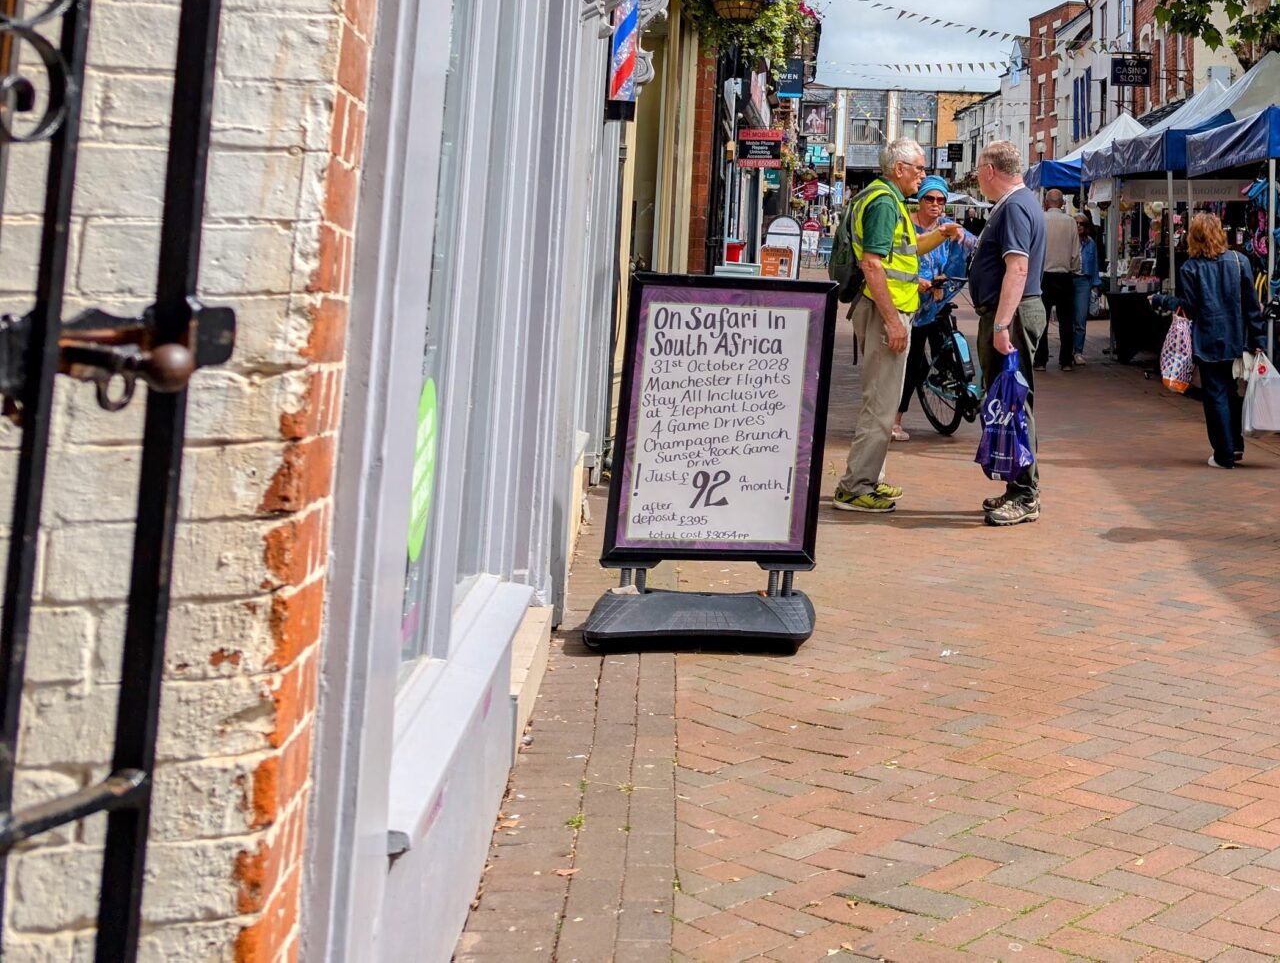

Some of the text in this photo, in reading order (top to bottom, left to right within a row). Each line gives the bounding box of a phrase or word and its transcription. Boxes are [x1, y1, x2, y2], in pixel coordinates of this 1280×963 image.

[1116, 66, 1148, 75] CASINO
[653, 307, 786, 339] On Safari In
[650, 331, 783, 357] South Africa
[651, 358, 789, 374] 31st October 2028
[644, 373, 791, 393] Manchester Flights
[642, 388, 779, 409] Stay All Inclusive
[646, 400, 786, 419] at Elephant Lodge
[651, 415, 766, 439] 4 Game Drives
[643, 428, 792, 452] Champagne Brunch
[655, 450, 704, 464] Sunset
[743, 444, 780, 455] Game
[687, 457, 721, 469] Drive
[644, 469, 680, 483] Just
[739, 474, 750, 483] a
[641, 501, 673, 514] after
[632, 512, 708, 527] deposit £395
[648, 531, 677, 539] total
[680, 531, 702, 539] cost
